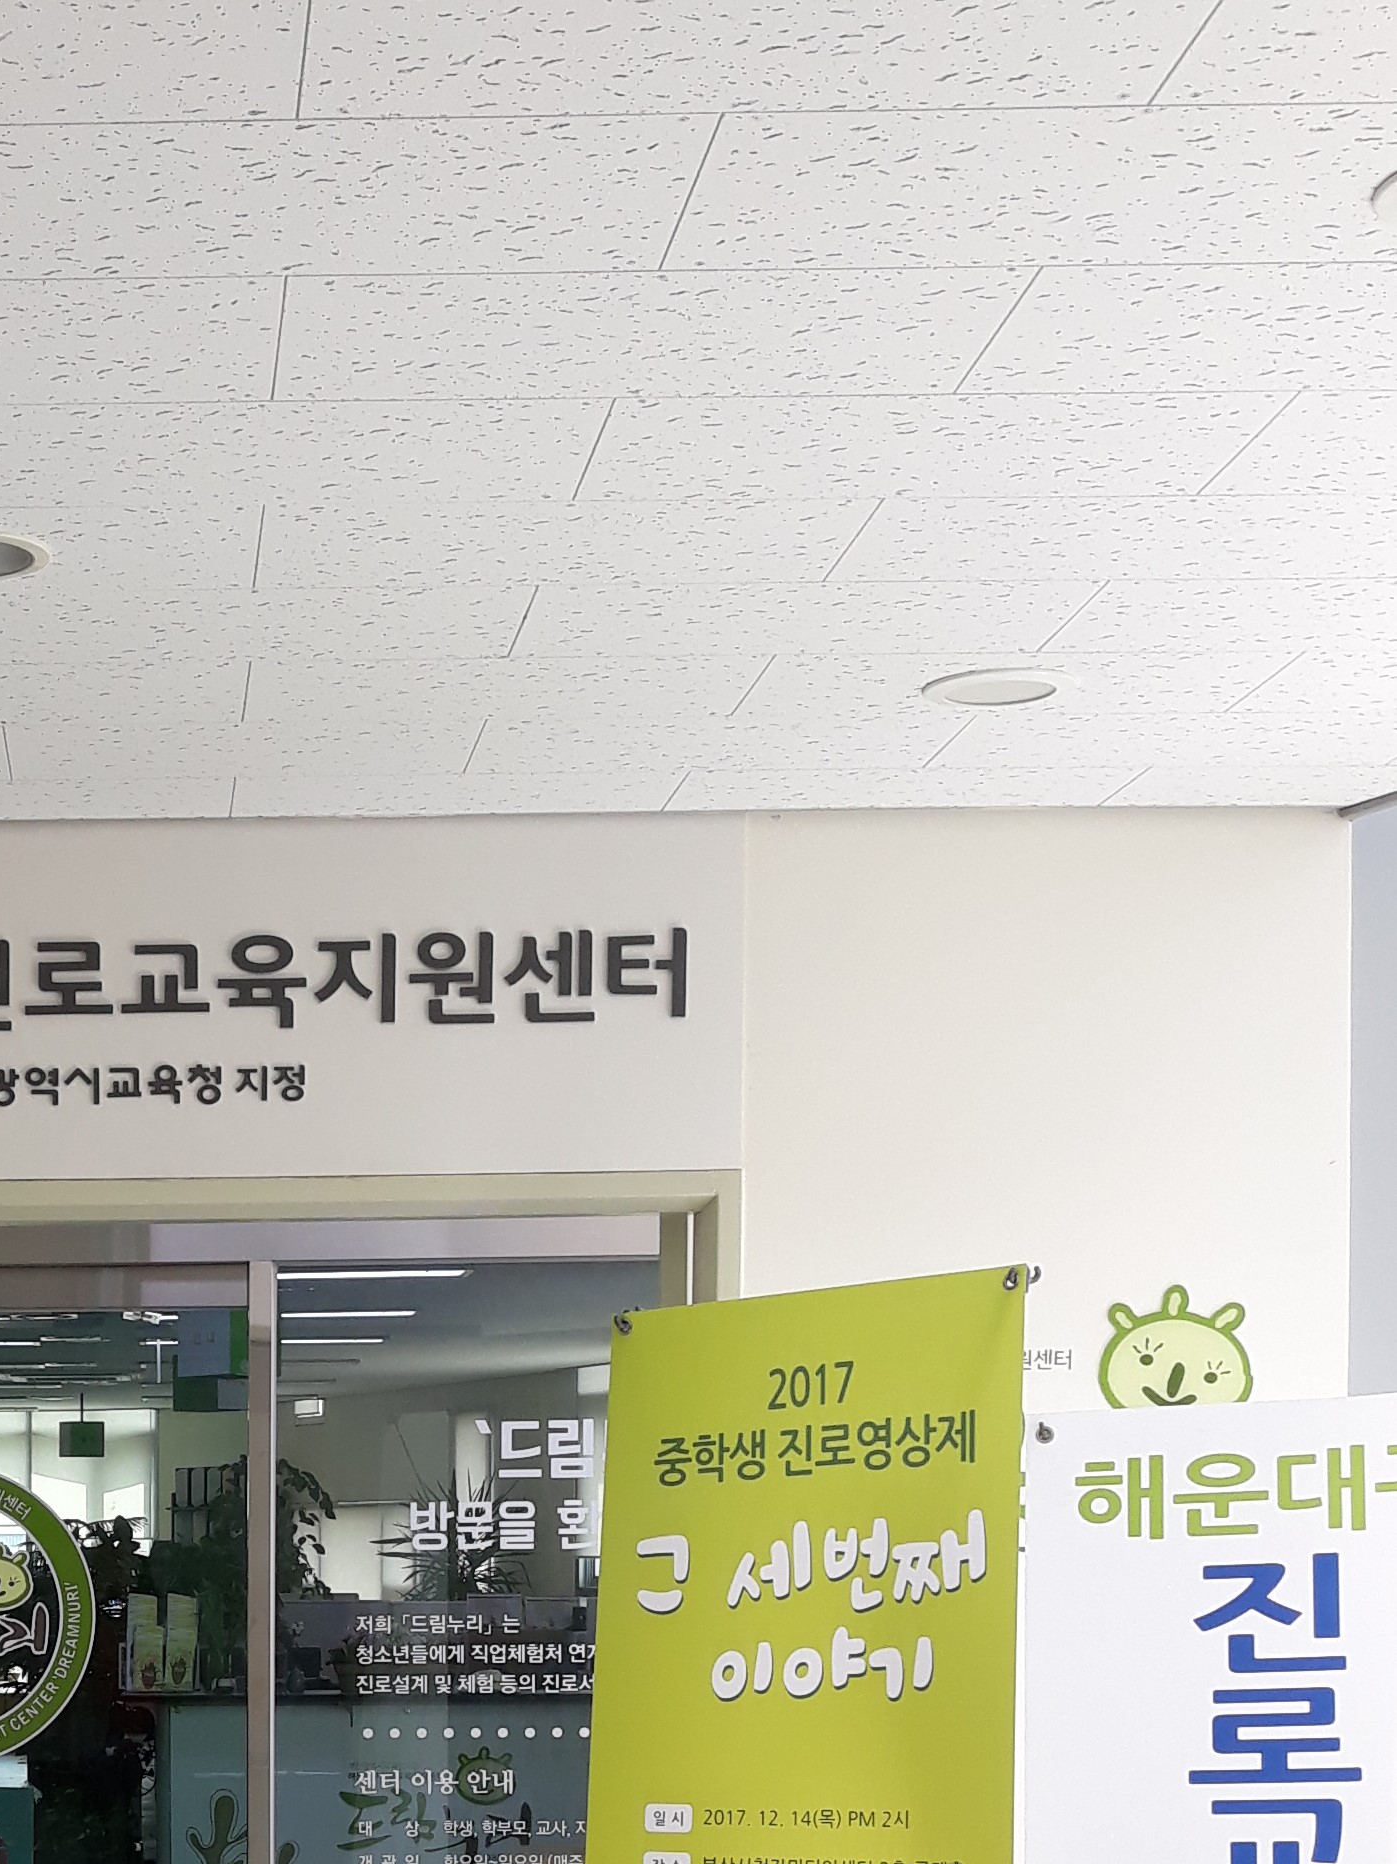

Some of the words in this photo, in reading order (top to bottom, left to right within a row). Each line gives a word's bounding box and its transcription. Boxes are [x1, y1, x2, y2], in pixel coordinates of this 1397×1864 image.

[234, 1062, 308, 1103] 지정
[767, 1361, 855, 1410] 2017
[654, 1428, 766, 1487] 중학생
[777, 1409, 977, 1477] 진로영상제
[1075, 1444, 1397, 1540] 해운대
[409, 1500, 536, 1550] 방문을
[636, 1535, 690, 1614] 그
[355, 1614, 392, 1635] 저희
[355, 1643, 465, 1664] 청소년들에게
[470, 1643, 562, 1664] 직업체험처
[710, 1625, 934, 1702] 이야기
[9, 1682, 60, 1731] CENTER
[355, 1674, 428, 1695] 진로설계
[435, 1674, 452, 1694] 및
[457, 1673, 494, 1694] 체험
[500, 1674, 536, 1694] 등의
[354, 1769, 400, 1795] 센터
[411, 1769, 459, 1795] 이용
[467, 1769, 514, 1795] 안내
[443, 1820, 477, 1837] 학생,
[536, 1820, 571, 1838] 교사,
[703, 1809, 751, 1827] 2017.
[759, 1809, 784, 1828] 12.
[791, 1808, 842, 1829] 14(목)
[848, 1810, 876, 1828] PM
[881, 1809, 910, 1829] 2시
